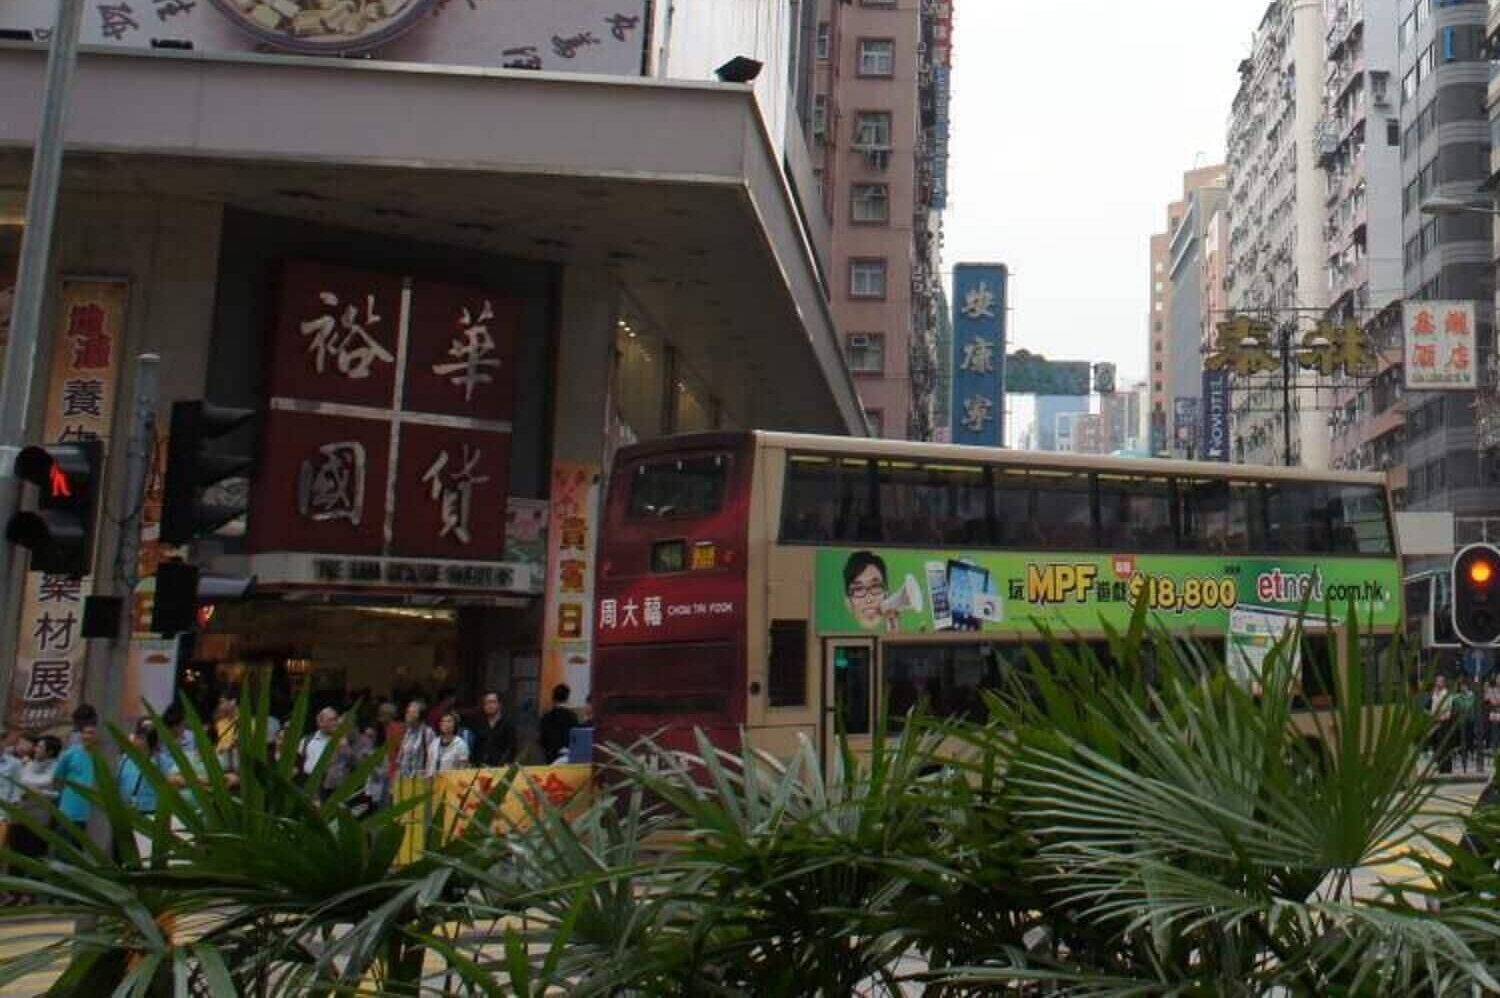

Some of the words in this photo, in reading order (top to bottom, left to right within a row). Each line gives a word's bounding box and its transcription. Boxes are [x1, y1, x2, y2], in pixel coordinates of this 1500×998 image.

[301, 291, 501, 401] 裕華
[1208, 376, 1225, 457] NOVOTEL
[299, 439, 491, 544] 國貨
[599, 595, 664, 630] 周大福
[1027, 563, 1098, 604] MPF
